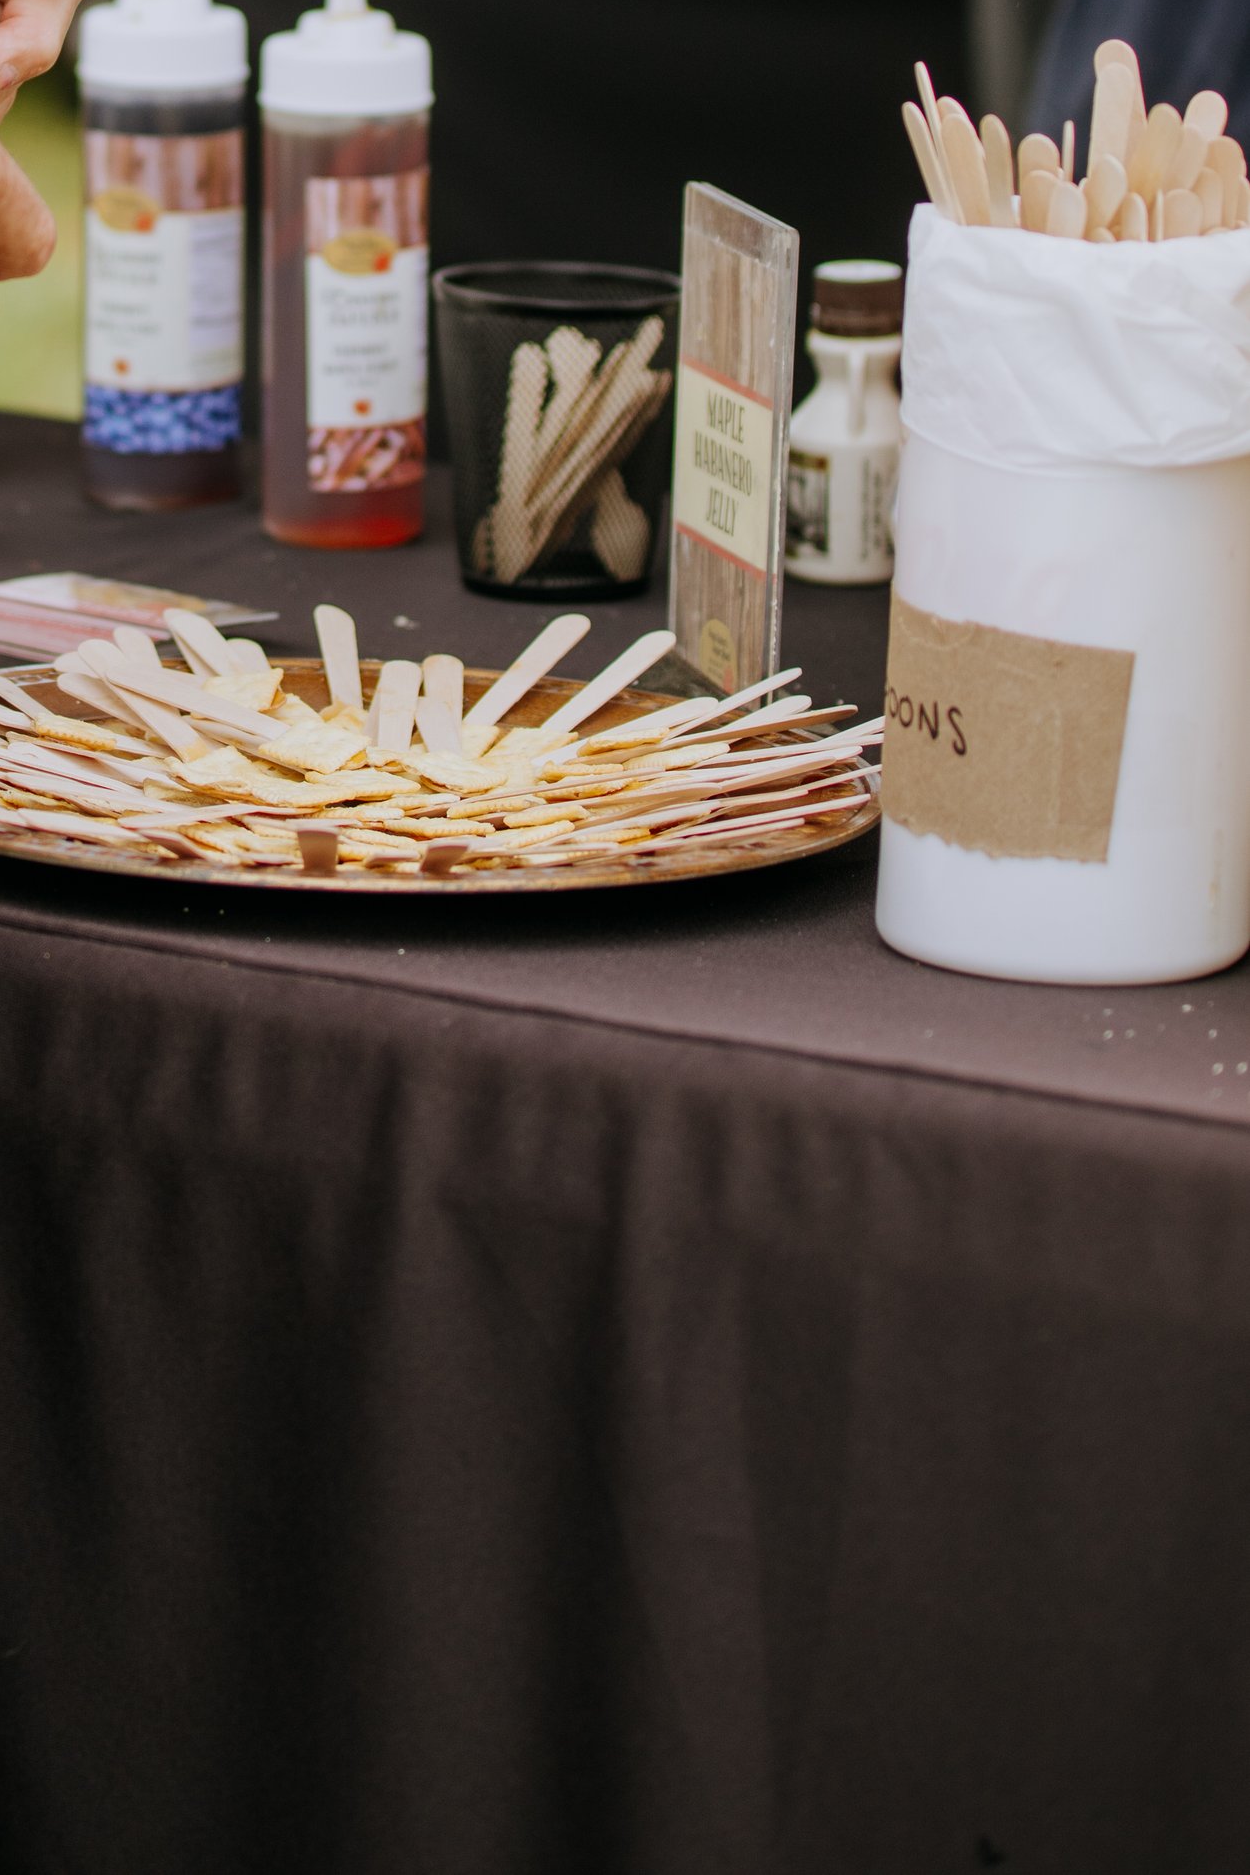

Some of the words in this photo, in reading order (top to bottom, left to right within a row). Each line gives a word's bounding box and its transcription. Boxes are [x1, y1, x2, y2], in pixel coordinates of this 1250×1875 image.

[706, 389, 746, 445] MAPLE
[694, 428, 753, 497] HABANERO
[705, 486, 740, 537] JELLY
[886, 685, 968, 758] OONS
